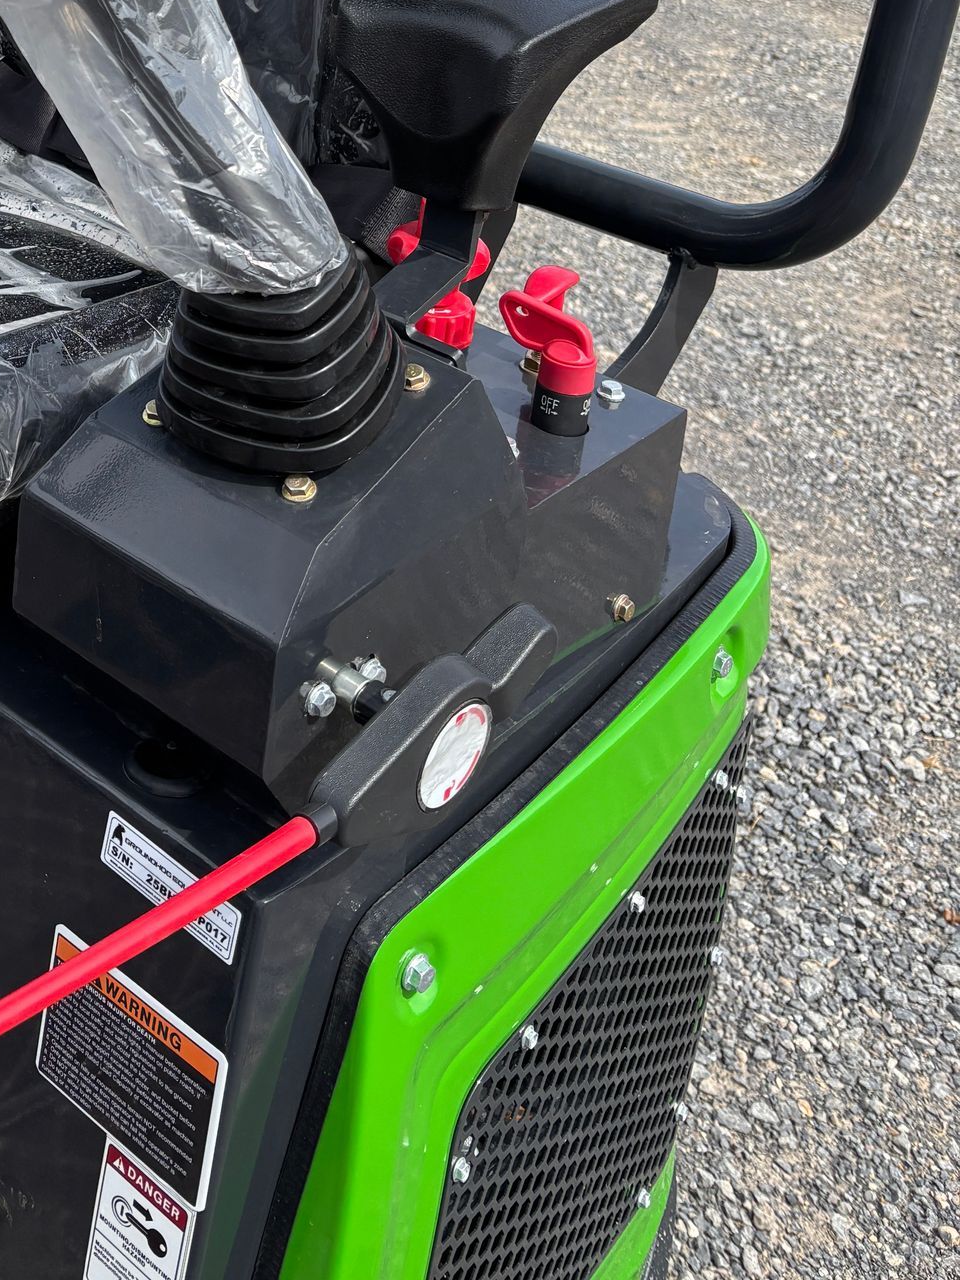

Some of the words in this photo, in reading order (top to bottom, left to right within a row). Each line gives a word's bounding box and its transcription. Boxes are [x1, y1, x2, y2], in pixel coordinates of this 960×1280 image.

[541, 395, 560, 410] OFF
[111, 845, 133, 870] S/N:
[125, 837, 172, 879] GROUNDHOG
[106, 976, 182, 1052] WARNING
[106, 999, 126, 1020] INJURY
[136, 1023, 155, 1044] DEATH
[143, 1117, 155, 1132] NOT
[127, 1165, 181, 1222] DANGER
[122, 1242, 146, 1268] HAZARD
